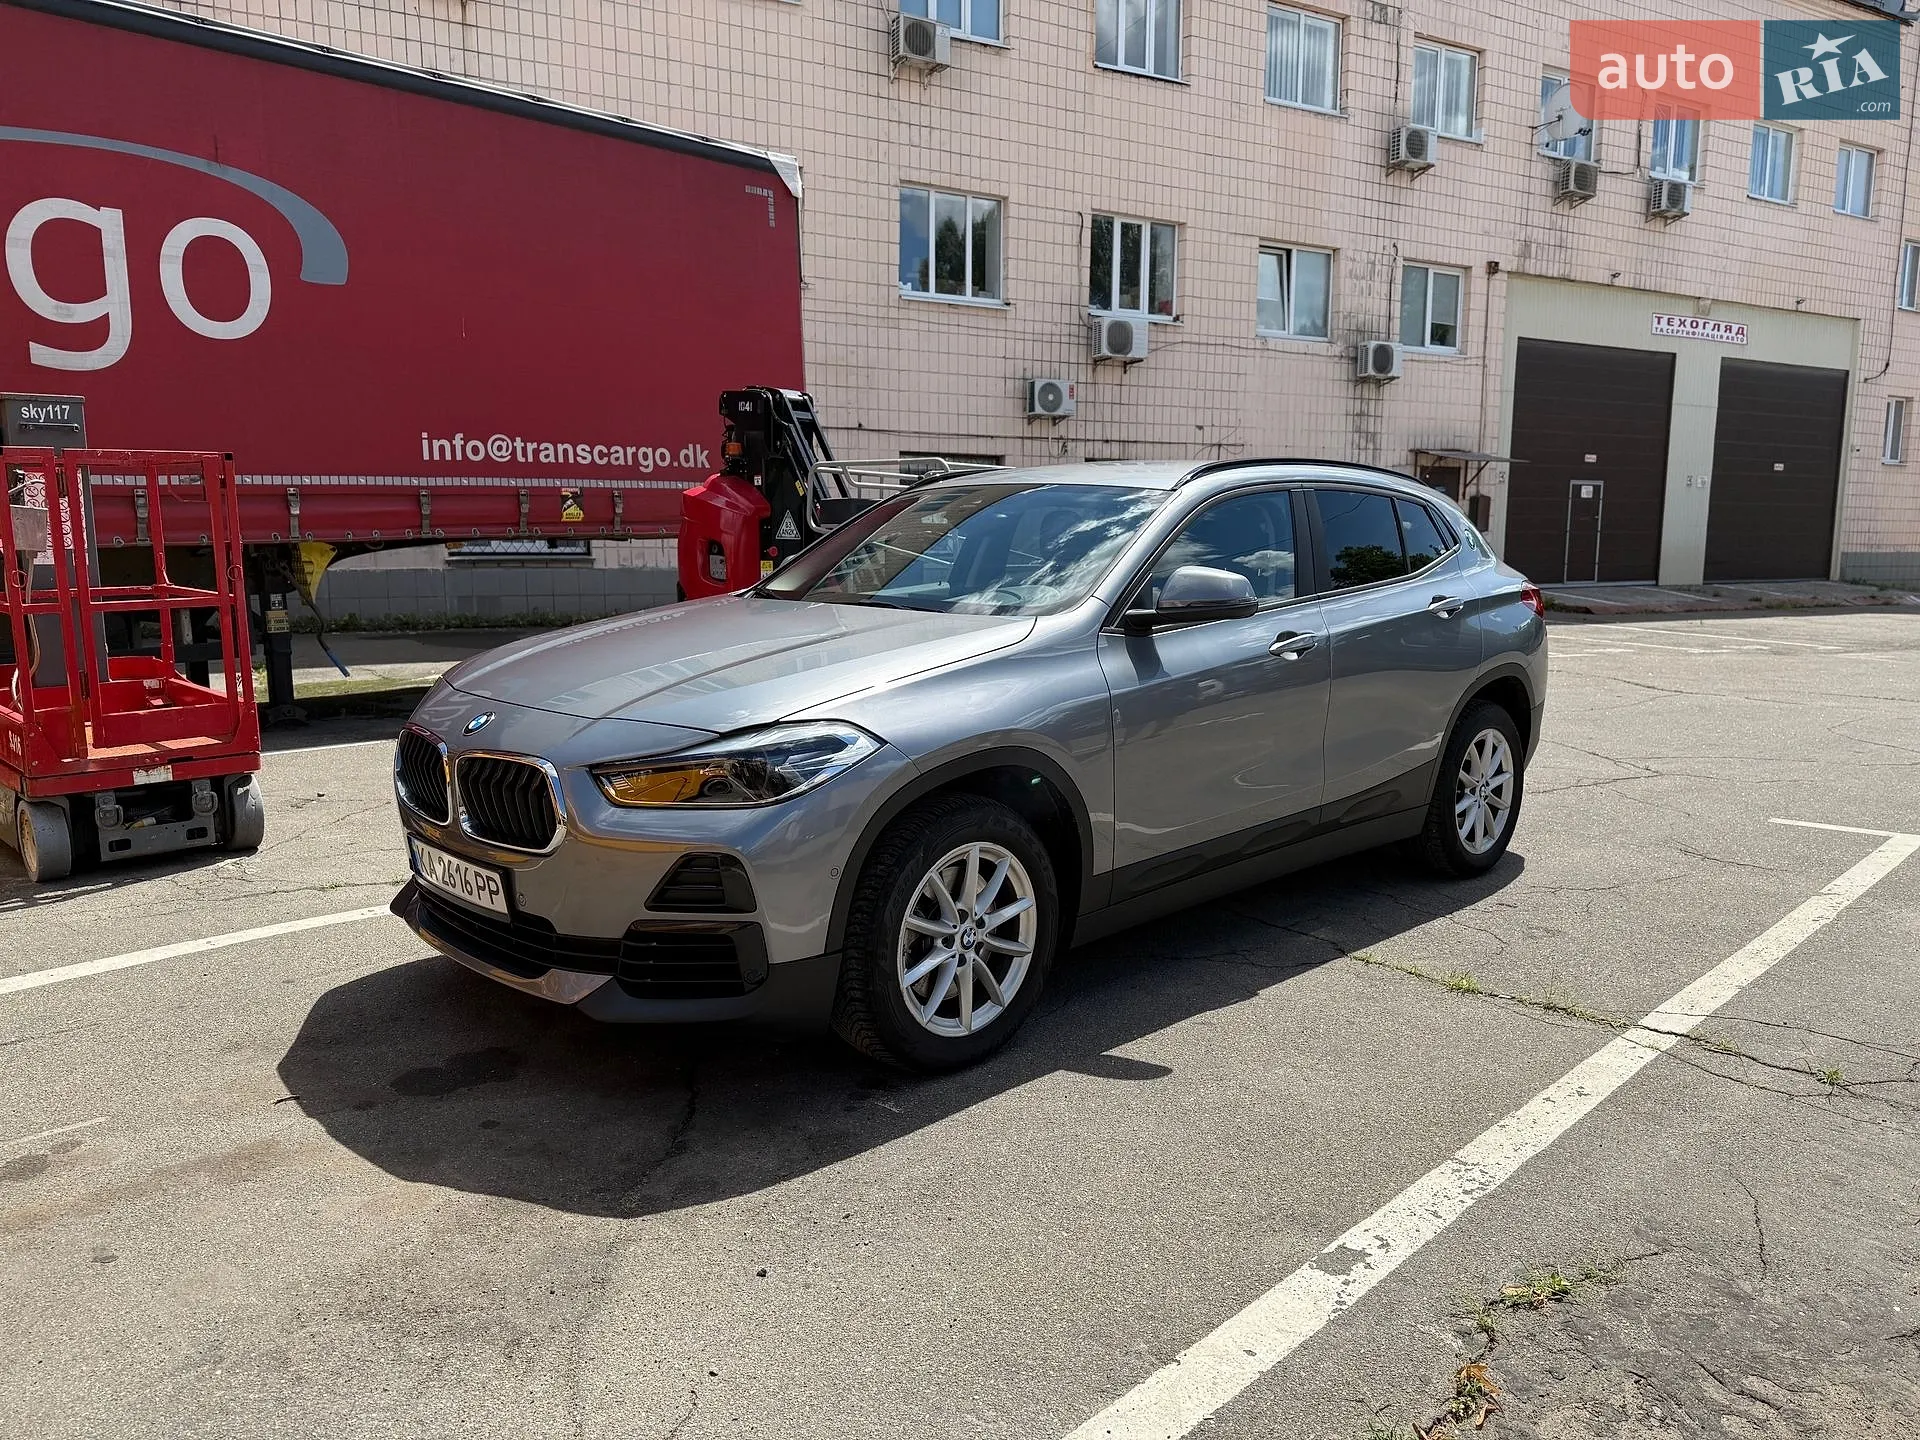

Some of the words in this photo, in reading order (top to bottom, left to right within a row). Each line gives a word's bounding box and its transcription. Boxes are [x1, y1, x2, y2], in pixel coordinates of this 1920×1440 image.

[5, 197, 272, 371] go
[1655, 315, 1745, 337] ТЕХОГЛЯД
[21, 404, 70, 422] sky117
[421, 432, 711, 473] info@transcargo.dk
[438, 856, 473, 896] 2616
[474, 870, 500, 905] PP
